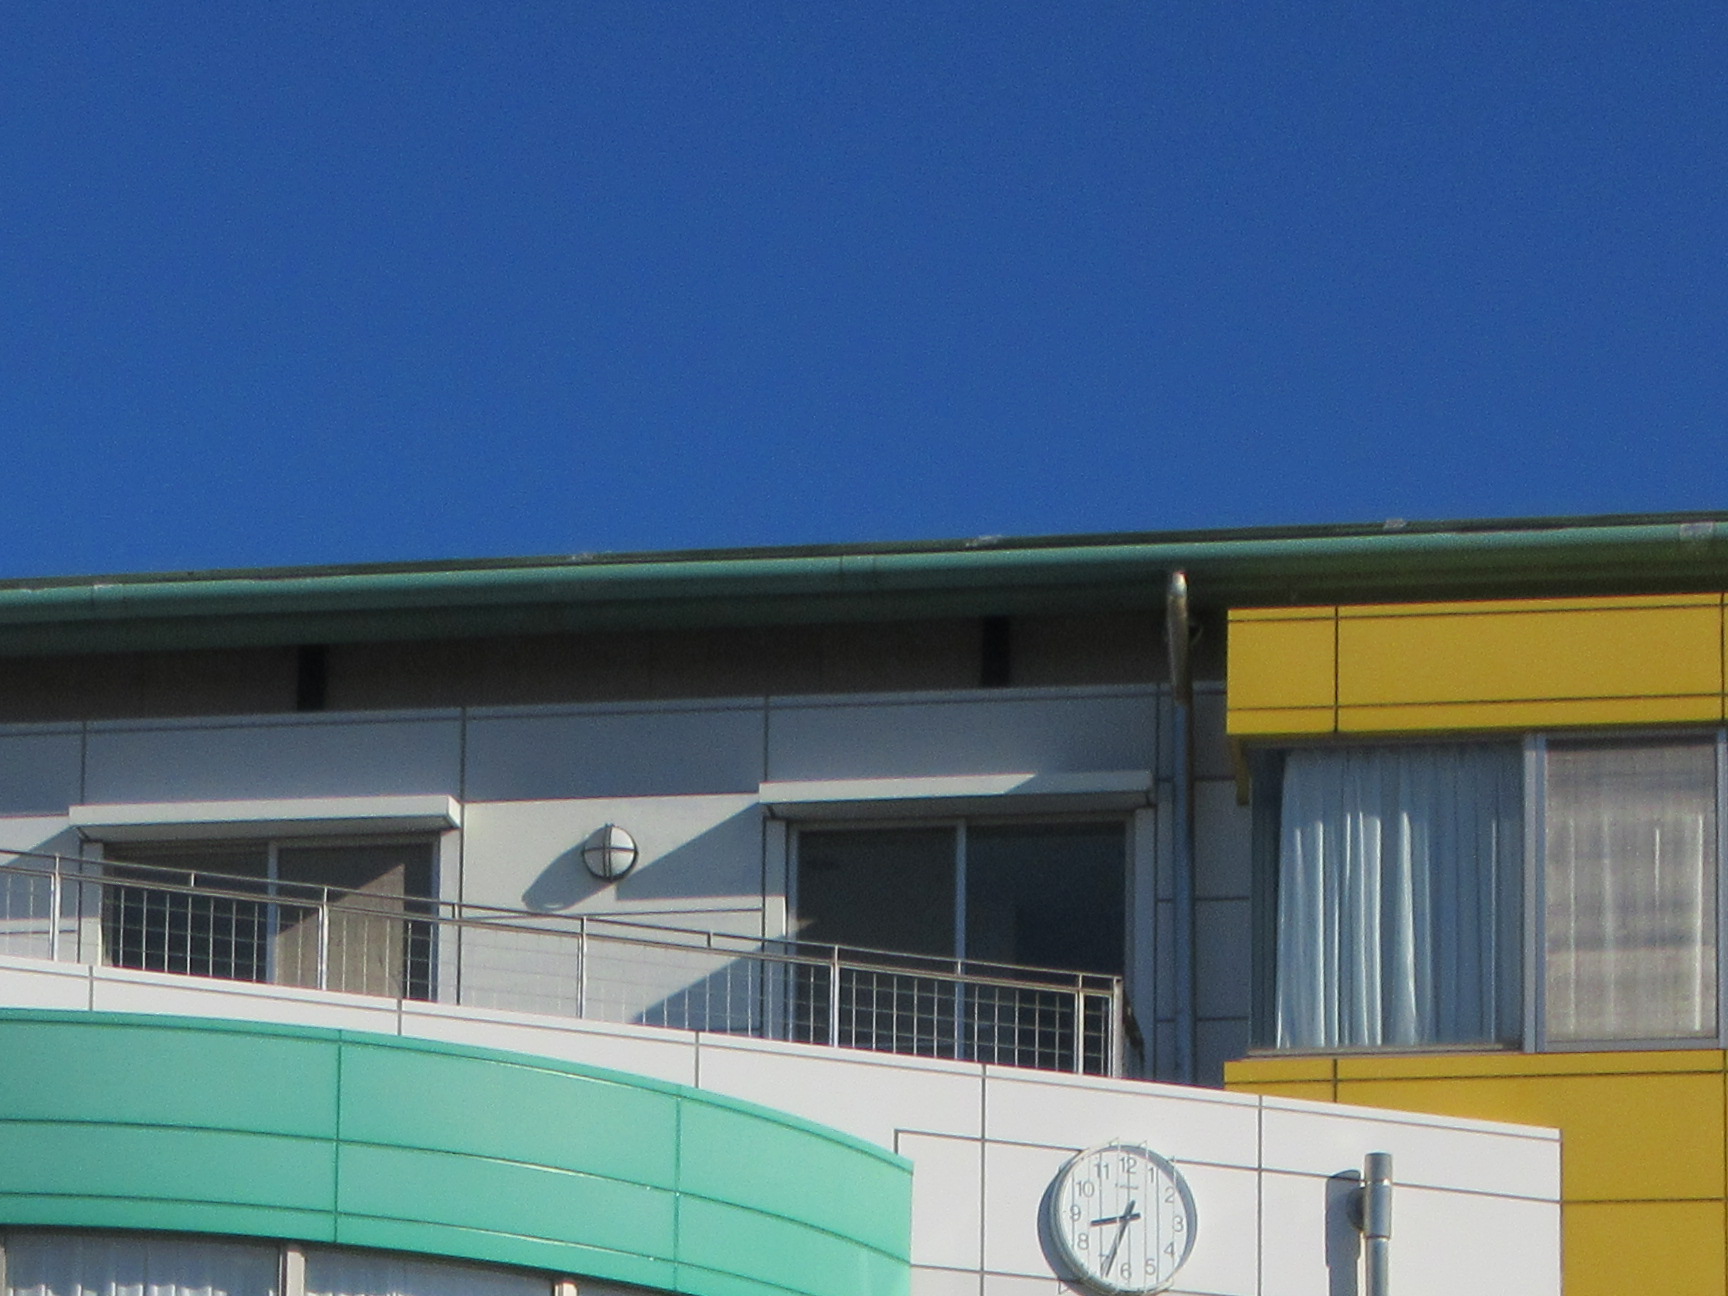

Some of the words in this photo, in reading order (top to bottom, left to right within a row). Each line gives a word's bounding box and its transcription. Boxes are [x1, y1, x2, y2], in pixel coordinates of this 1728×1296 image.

[1094, 1163, 1109, 1180] 11
[1120, 1156, 1138, 1175] 12
[1148, 1166, 1154, 1183] 1
[1076, 1180, 1095, 1198] 10
[1164, 1186, 1176, 1203] 2
[1069, 1204, 1081, 1222] 9
[1172, 1215, 1184, 1233] 3
[1077, 1232, 1089, 1251] 8
[1163, 1241, 1176, 1259] 4
[1120, 1262, 1132, 1280] 6
[1145, 1258, 1156, 1276] 5
